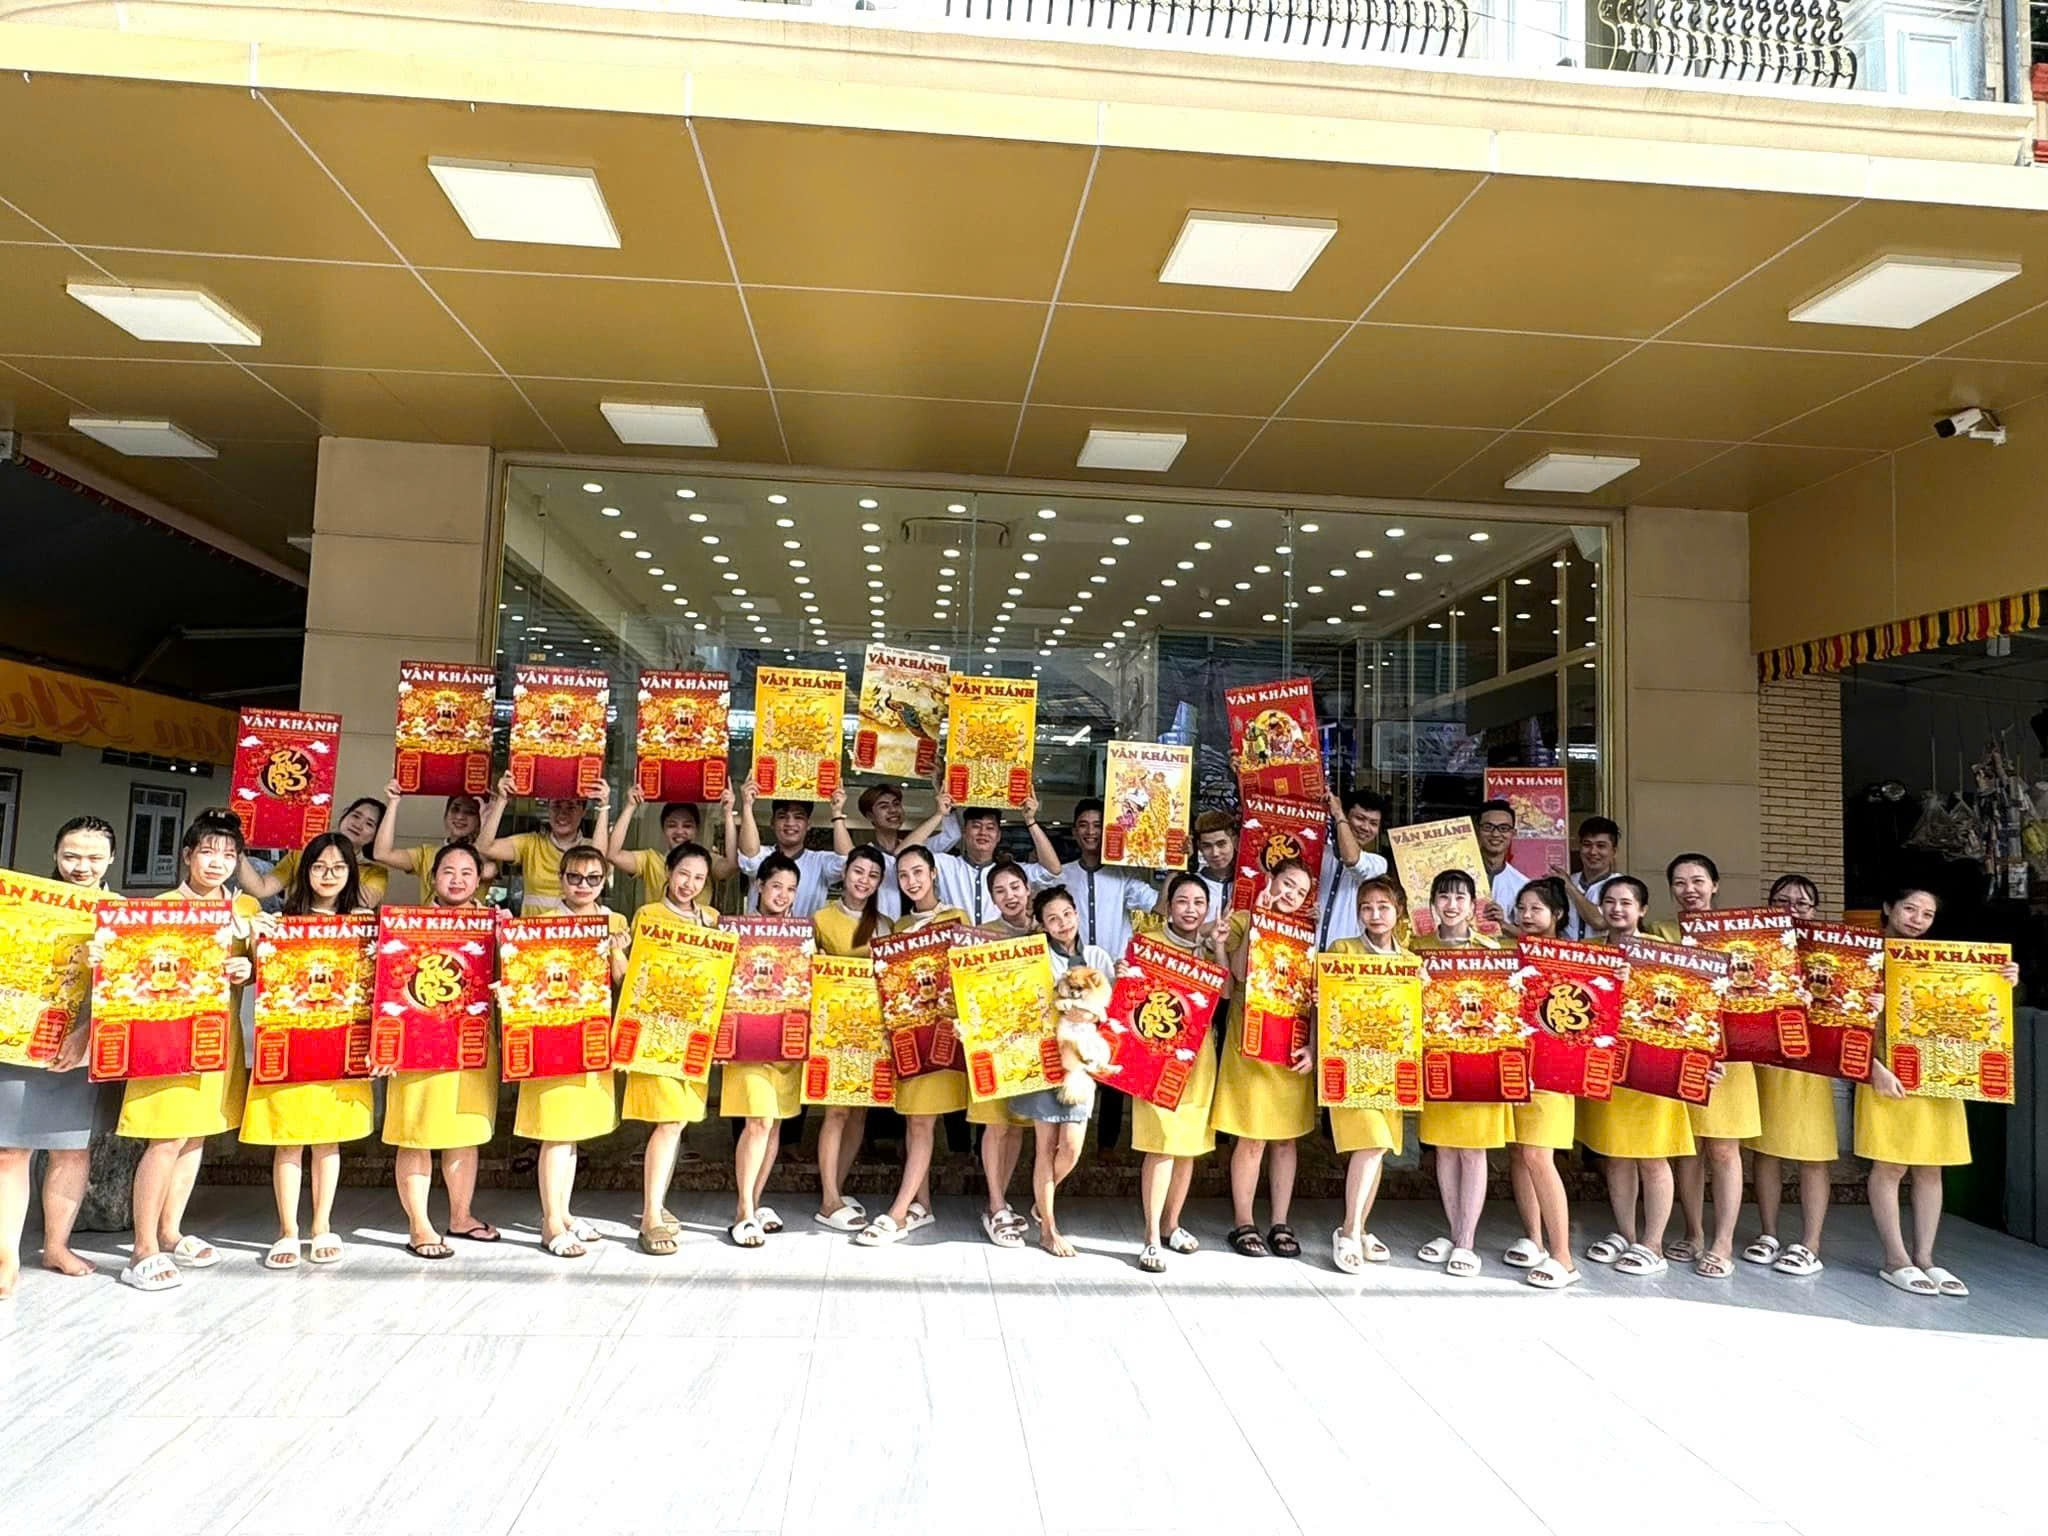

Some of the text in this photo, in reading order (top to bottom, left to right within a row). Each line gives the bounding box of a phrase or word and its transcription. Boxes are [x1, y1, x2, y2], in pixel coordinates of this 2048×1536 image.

[868, 652, 947, 673] VÂN KHÁNH
[401, 666, 495, 685] VÂN KHÁNH
[517, 670, 549, 684] VÂN
[552, 674, 609, 689] KHÁNH
[640, 675, 671, 689] VÂN
[674, 677, 729, 691] KHÁNH
[760, 673, 843, 690] VÂN KHÁNH
[952, 681, 981, 695] VÂN
[984, 684, 1035, 698] KHÁNH
[1226, 685, 1309, 705] VÂN KHÁNH
[241, 714, 339, 733] VÂN KHÁNH
[1111, 747, 1190, 764] VÂN KHÁNH
[1487, 775, 1563, 786] VÂN KHÁNH
[1246, 799, 1326, 821] VÂN KHÁNH
[1391, 824, 1472, 845] VÂN KHÁNH
[0, 879, 97, 914] ÂN KHÁN
[99, 907, 231, 925] VÂN KHÁNH
[383, 914, 422, 930] VÂN
[426, 915, 494, 931] KHÁNH
[1680, 914, 1792, 933] VÂN KHÁNH
[308, 922, 380, 939] KHÁNH
[503, 923, 608, 940] VÂN KHÁNH
[640, 923, 735, 952] VÂN KHÁNH
[754, 922, 813, 938] KHÁNH
[1252, 913, 1315, 944] VÂN KHÁNH
[873, 928, 951, 958] VÂN KHÁN
[1813, 930, 1883, 950] KHÁNH
[951, 943, 1046, 968] VÂN KHÁNH
[1456, 955, 1520, 971] KHÁNH
[1519, 942, 1624, 968] VÂN KHÁNH
[1660, 950, 1728, 975] KHÁNH
[1888, 945, 2008, 965] VÂN KHÁNH
[814, 962, 845, 976] VÂN
[1132, 942, 1225, 989] VÂN KHÁNH
[1320, 960, 1419, 977] VÂN KHÁNH
